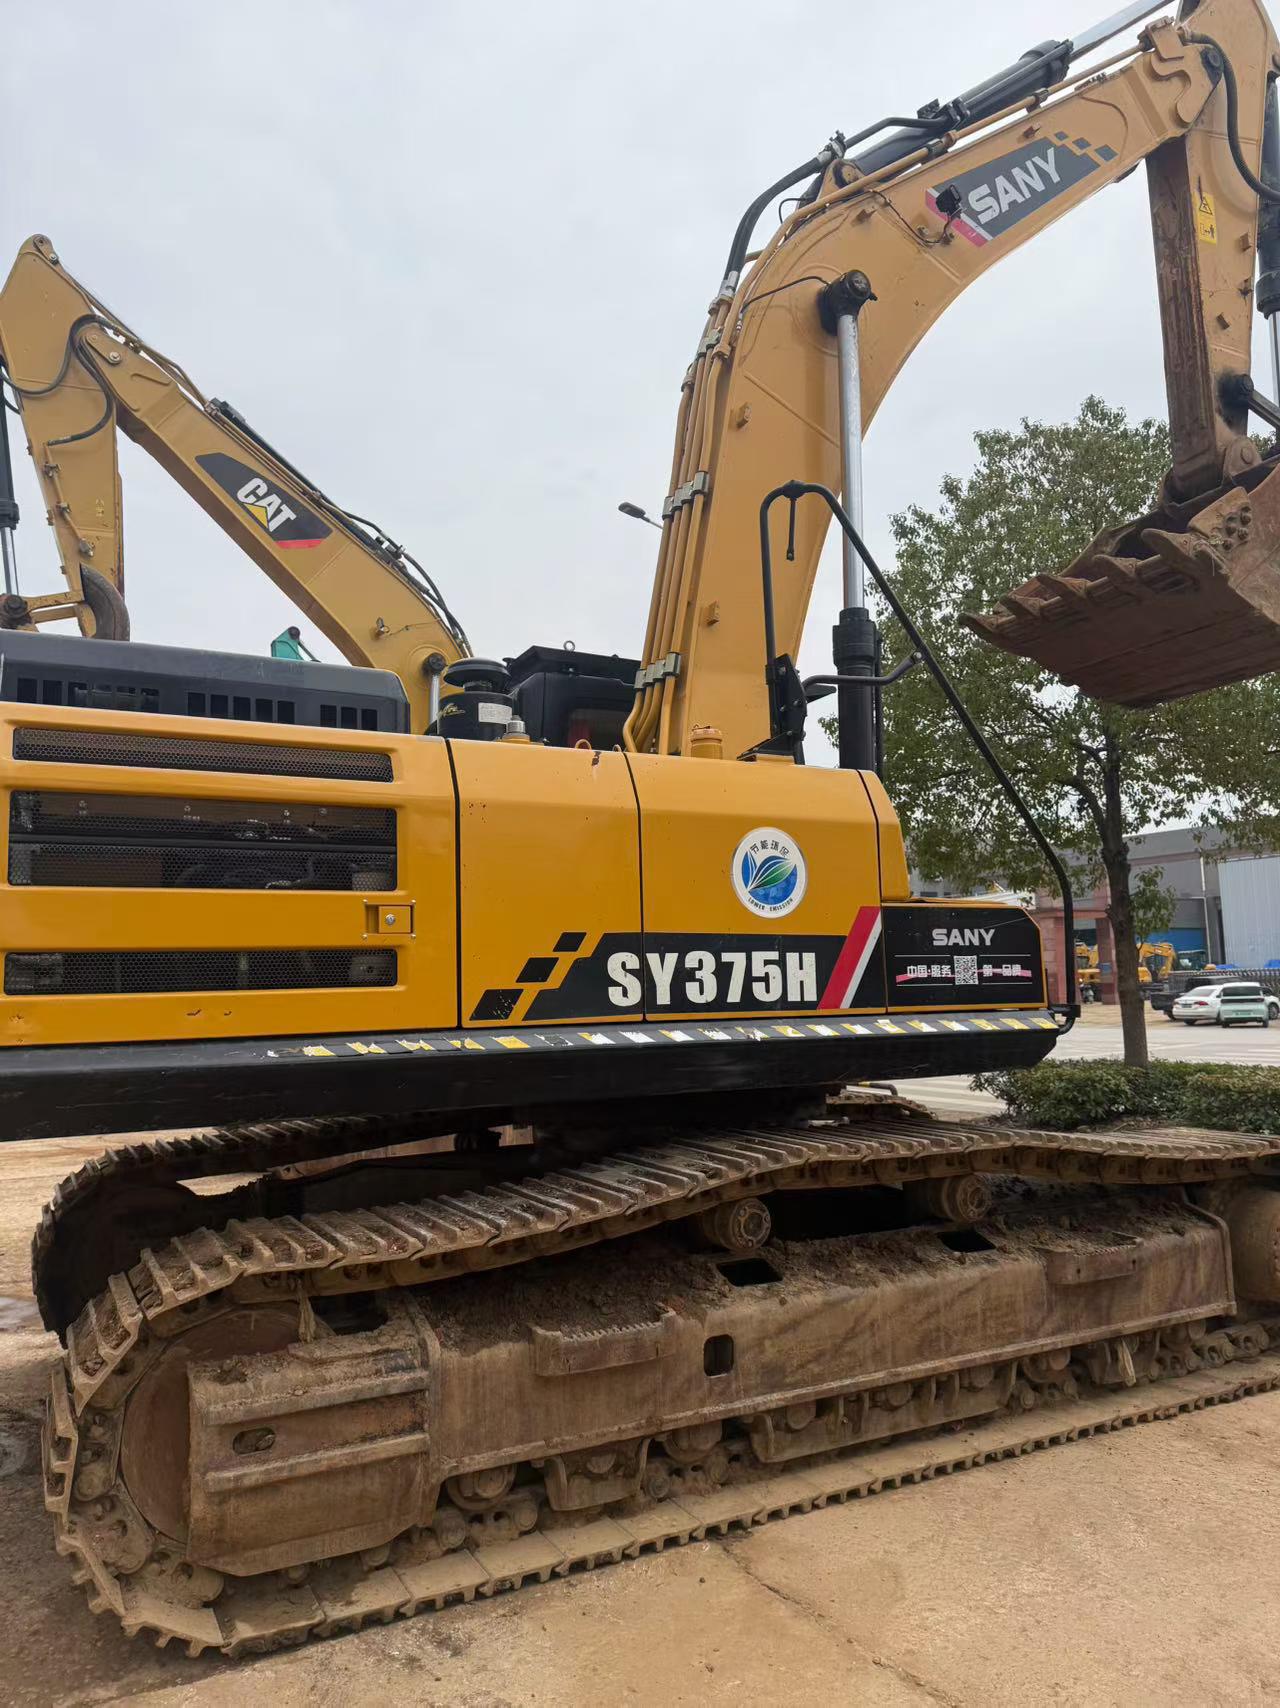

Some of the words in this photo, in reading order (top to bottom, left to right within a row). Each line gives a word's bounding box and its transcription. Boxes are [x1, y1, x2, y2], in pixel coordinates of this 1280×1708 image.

[968, 147, 1060, 225] SANY
[237, 477, 297, 532] CAT
[748, 897, 766, 911] LOWER
[769, 897, 794, 912] EMISSION
[932, 928, 995, 946] SANY
[607, 950, 817, 1007] SY375H
